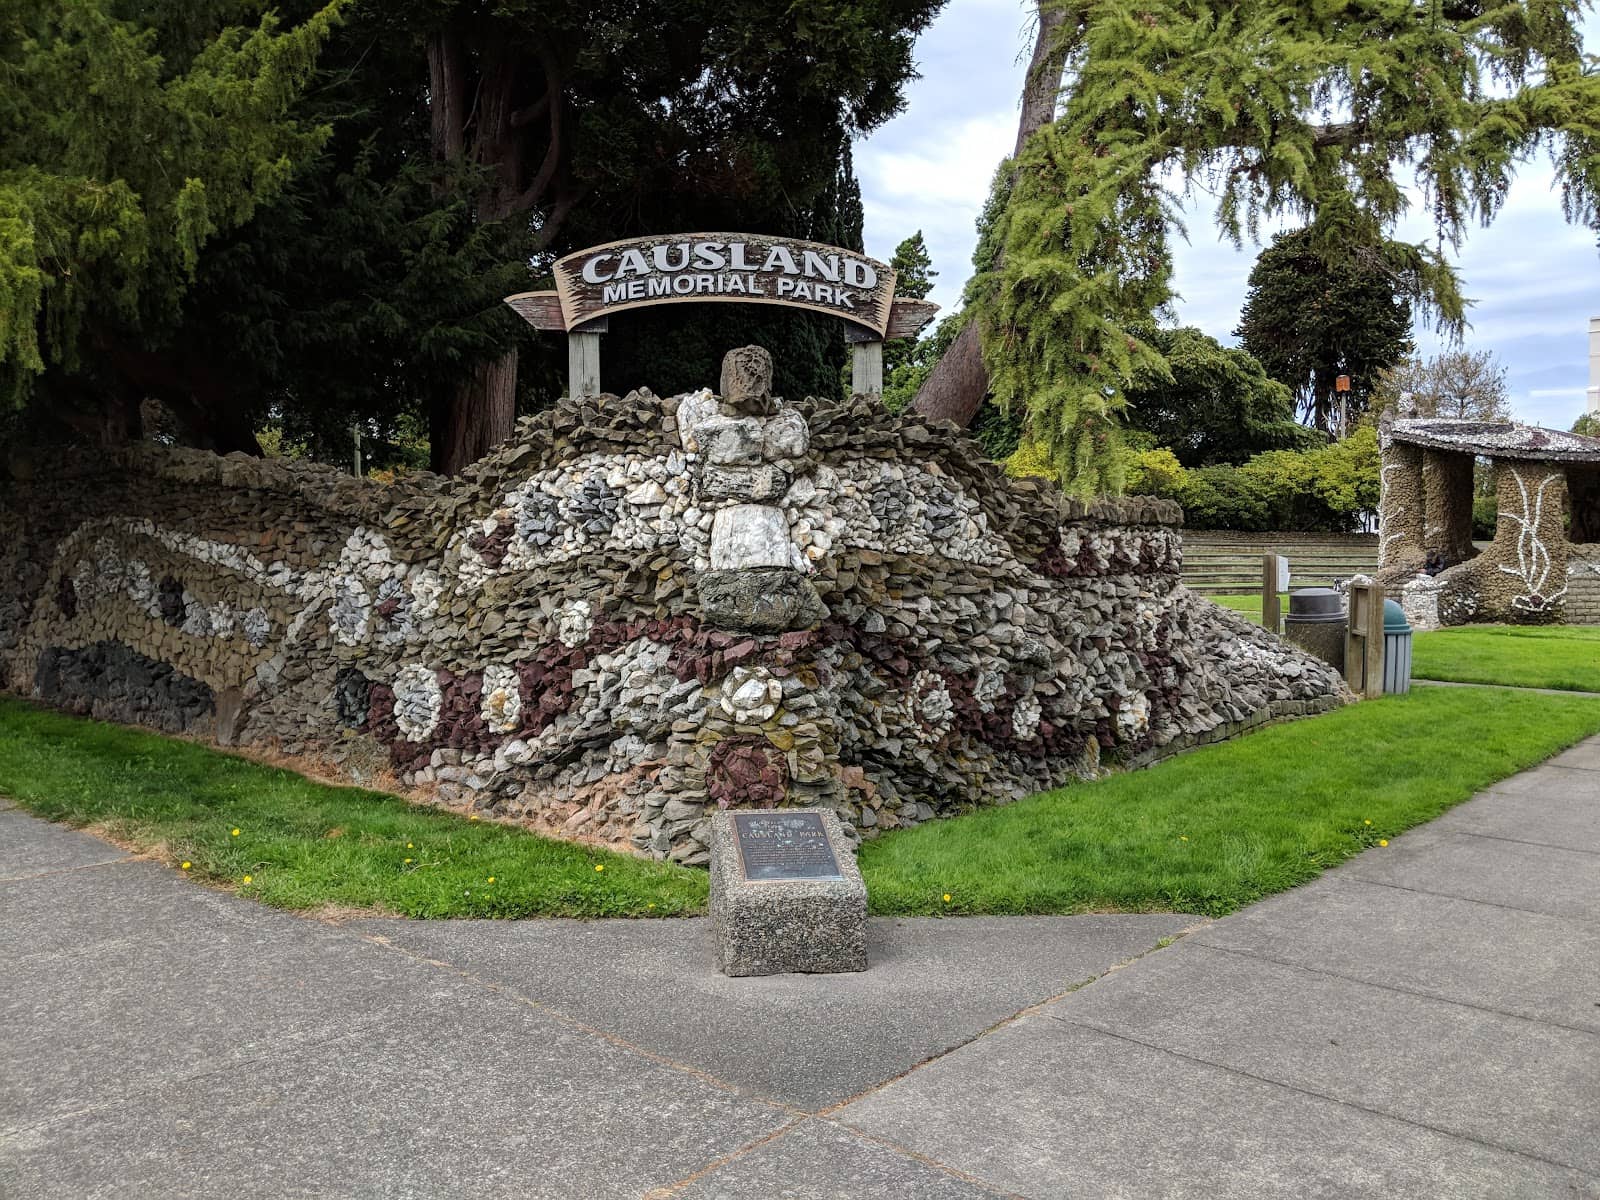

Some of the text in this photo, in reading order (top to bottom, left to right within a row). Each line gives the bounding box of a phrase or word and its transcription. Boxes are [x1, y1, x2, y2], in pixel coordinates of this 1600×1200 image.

[582, 242, 877, 289] CAUSLAND
[603, 274, 855, 309] MEMORIAL PARK
